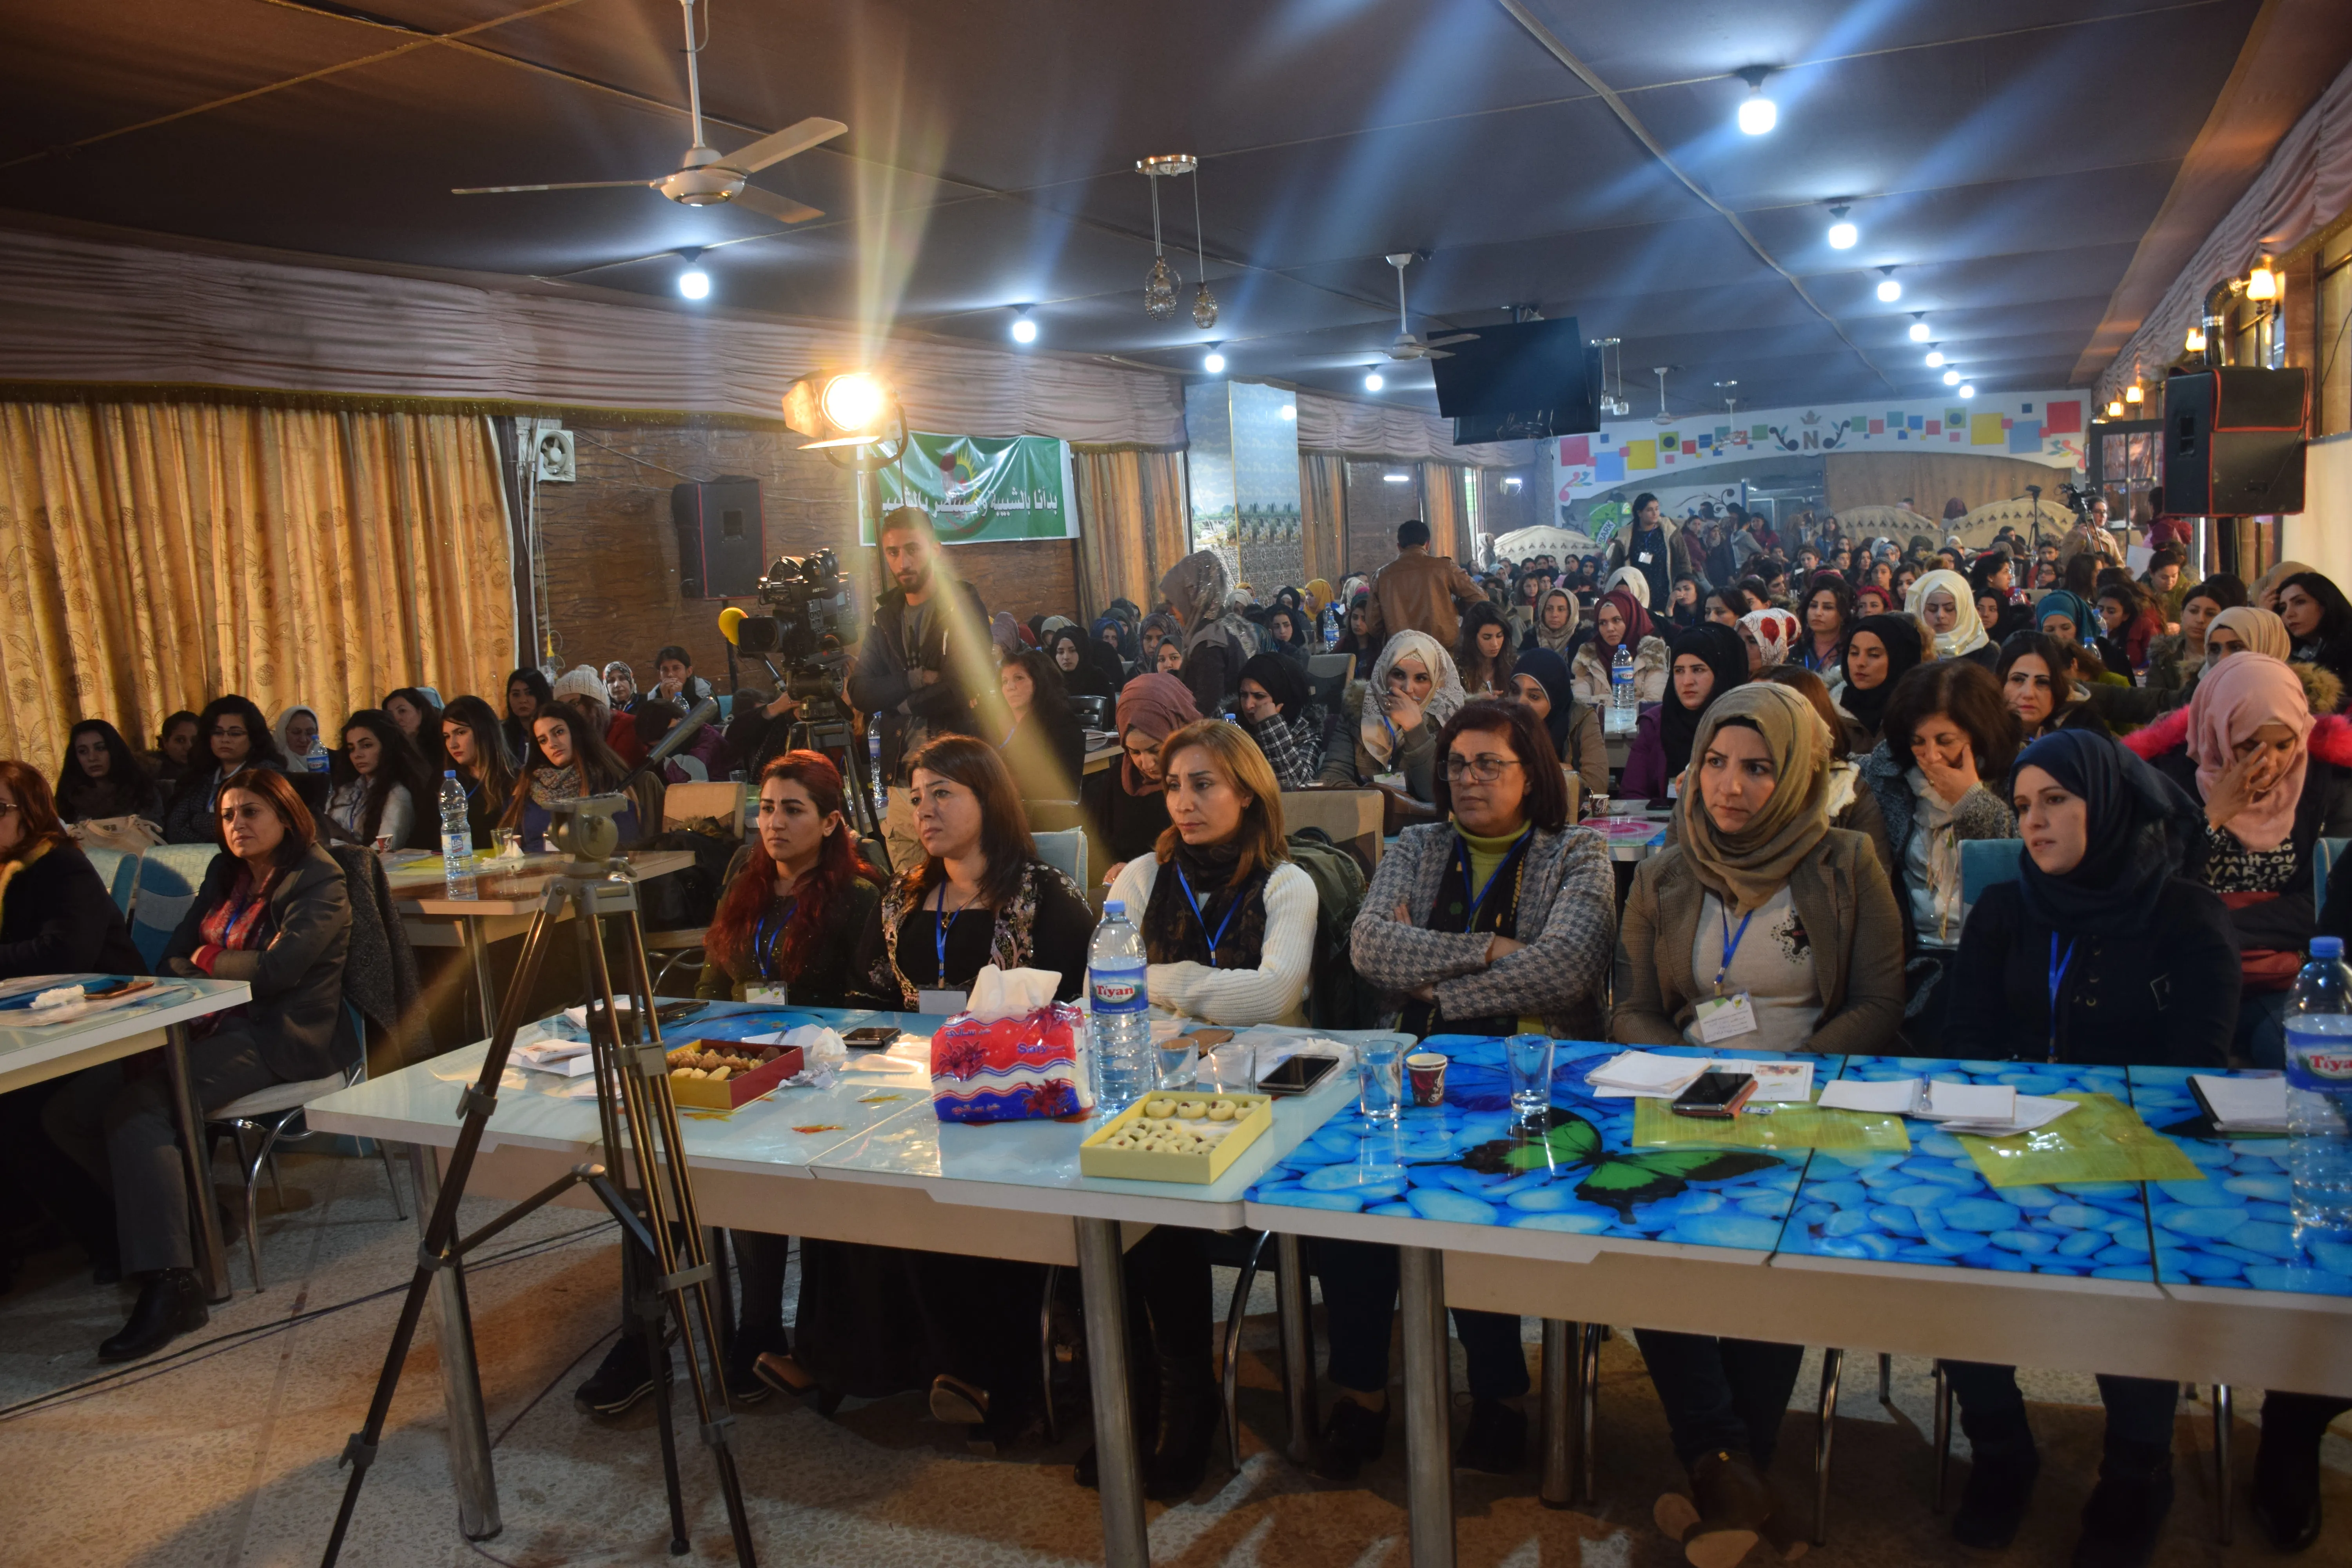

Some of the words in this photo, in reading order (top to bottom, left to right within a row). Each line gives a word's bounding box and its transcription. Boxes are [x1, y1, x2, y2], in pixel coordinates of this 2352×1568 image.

[1803, 430, 1818, 450] N
[882, 486, 929, 517] بالشبيب
[988, 486, 1031, 517] بالشبيبة
[1034, 485, 1058, 515] بدأنا
[1096, 985, 1134, 998] Tiyan
